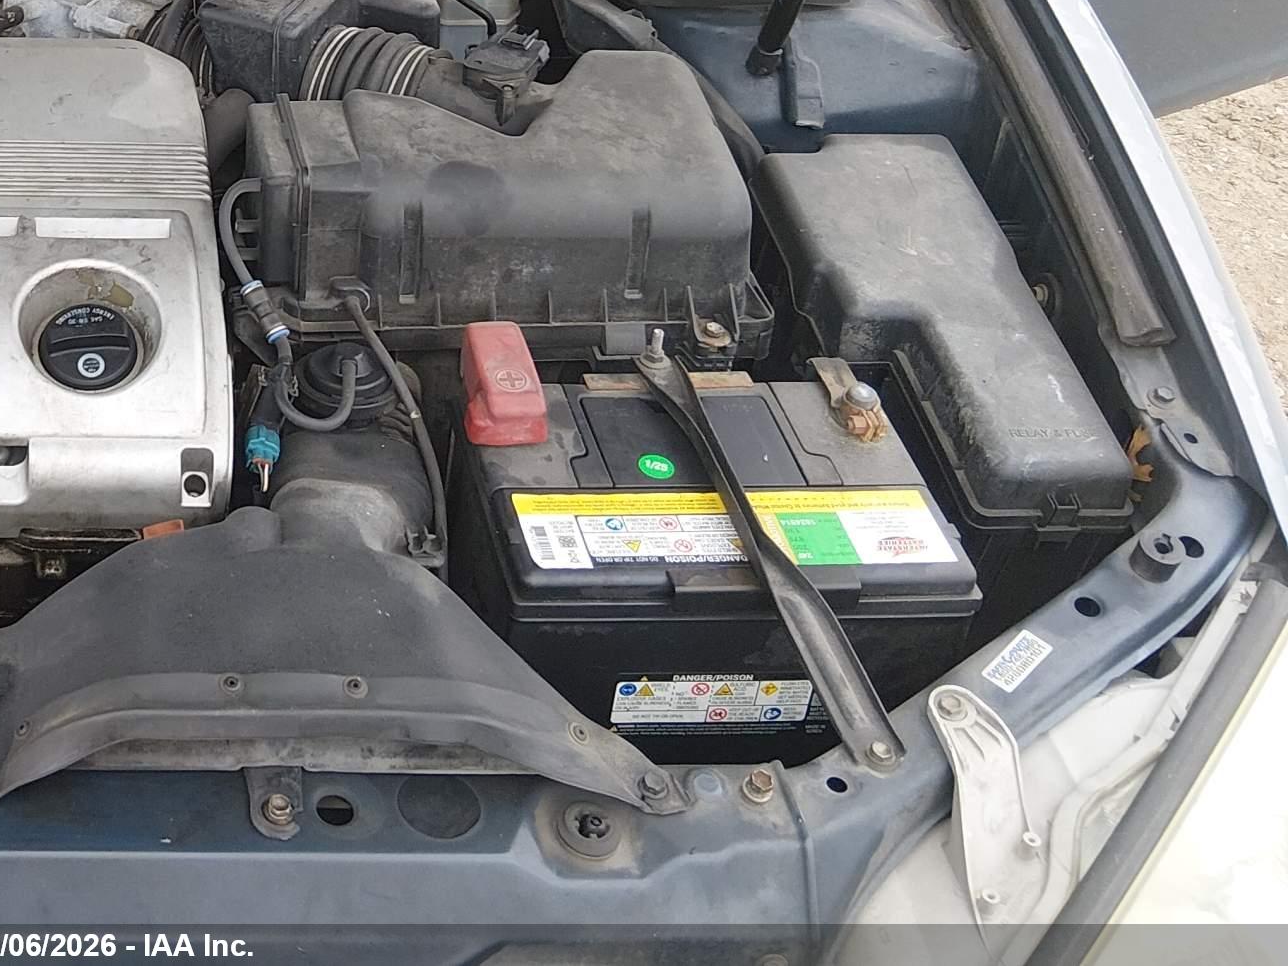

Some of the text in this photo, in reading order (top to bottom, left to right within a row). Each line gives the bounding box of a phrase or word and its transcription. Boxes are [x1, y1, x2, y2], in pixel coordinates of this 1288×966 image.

[1008, 429, 1049, 438] RELAY
[664, 555, 748, 563] DANGER/POISON
[672, 674, 754, 682] DANGER/POISON
